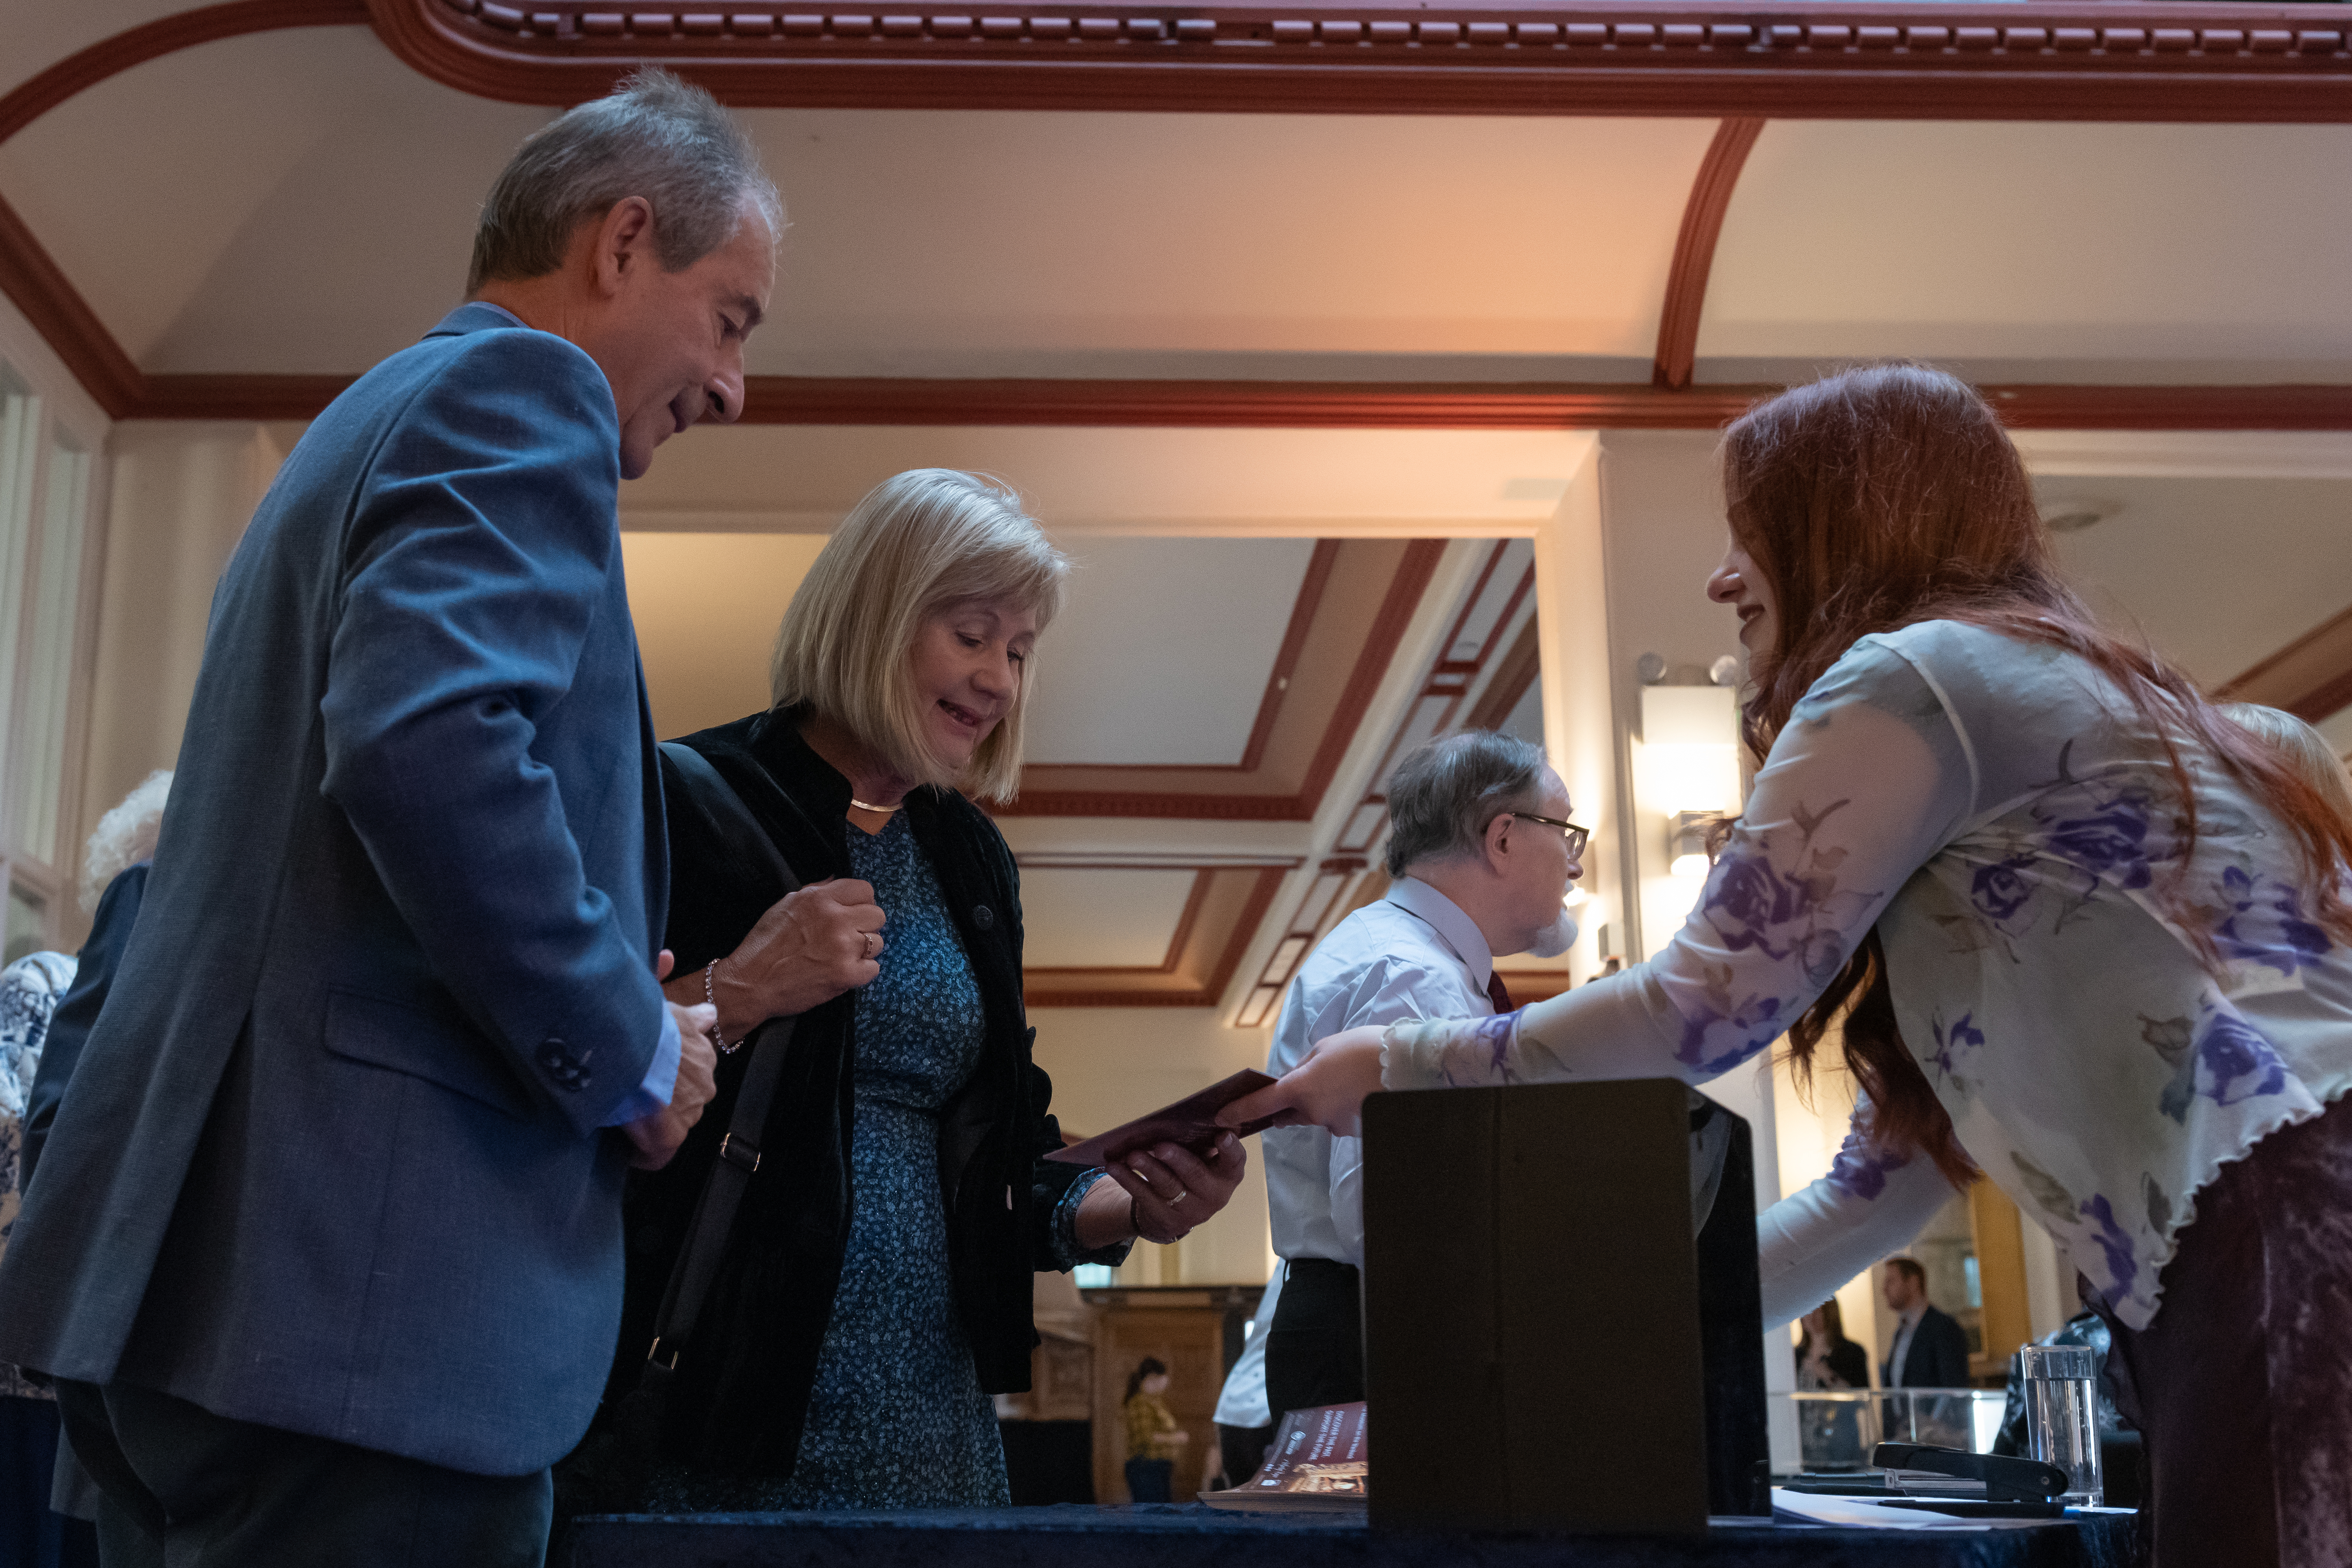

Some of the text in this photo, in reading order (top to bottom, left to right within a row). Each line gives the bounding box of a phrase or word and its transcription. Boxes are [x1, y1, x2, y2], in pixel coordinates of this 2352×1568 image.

[1319, 1410, 1334, 1433] SUPPORT
[1330, 1410, 1345, 1436] DISCOVER
[1315, 1433, 1327, 1443] THE
[1326, 1436, 1338, 1446] THE
